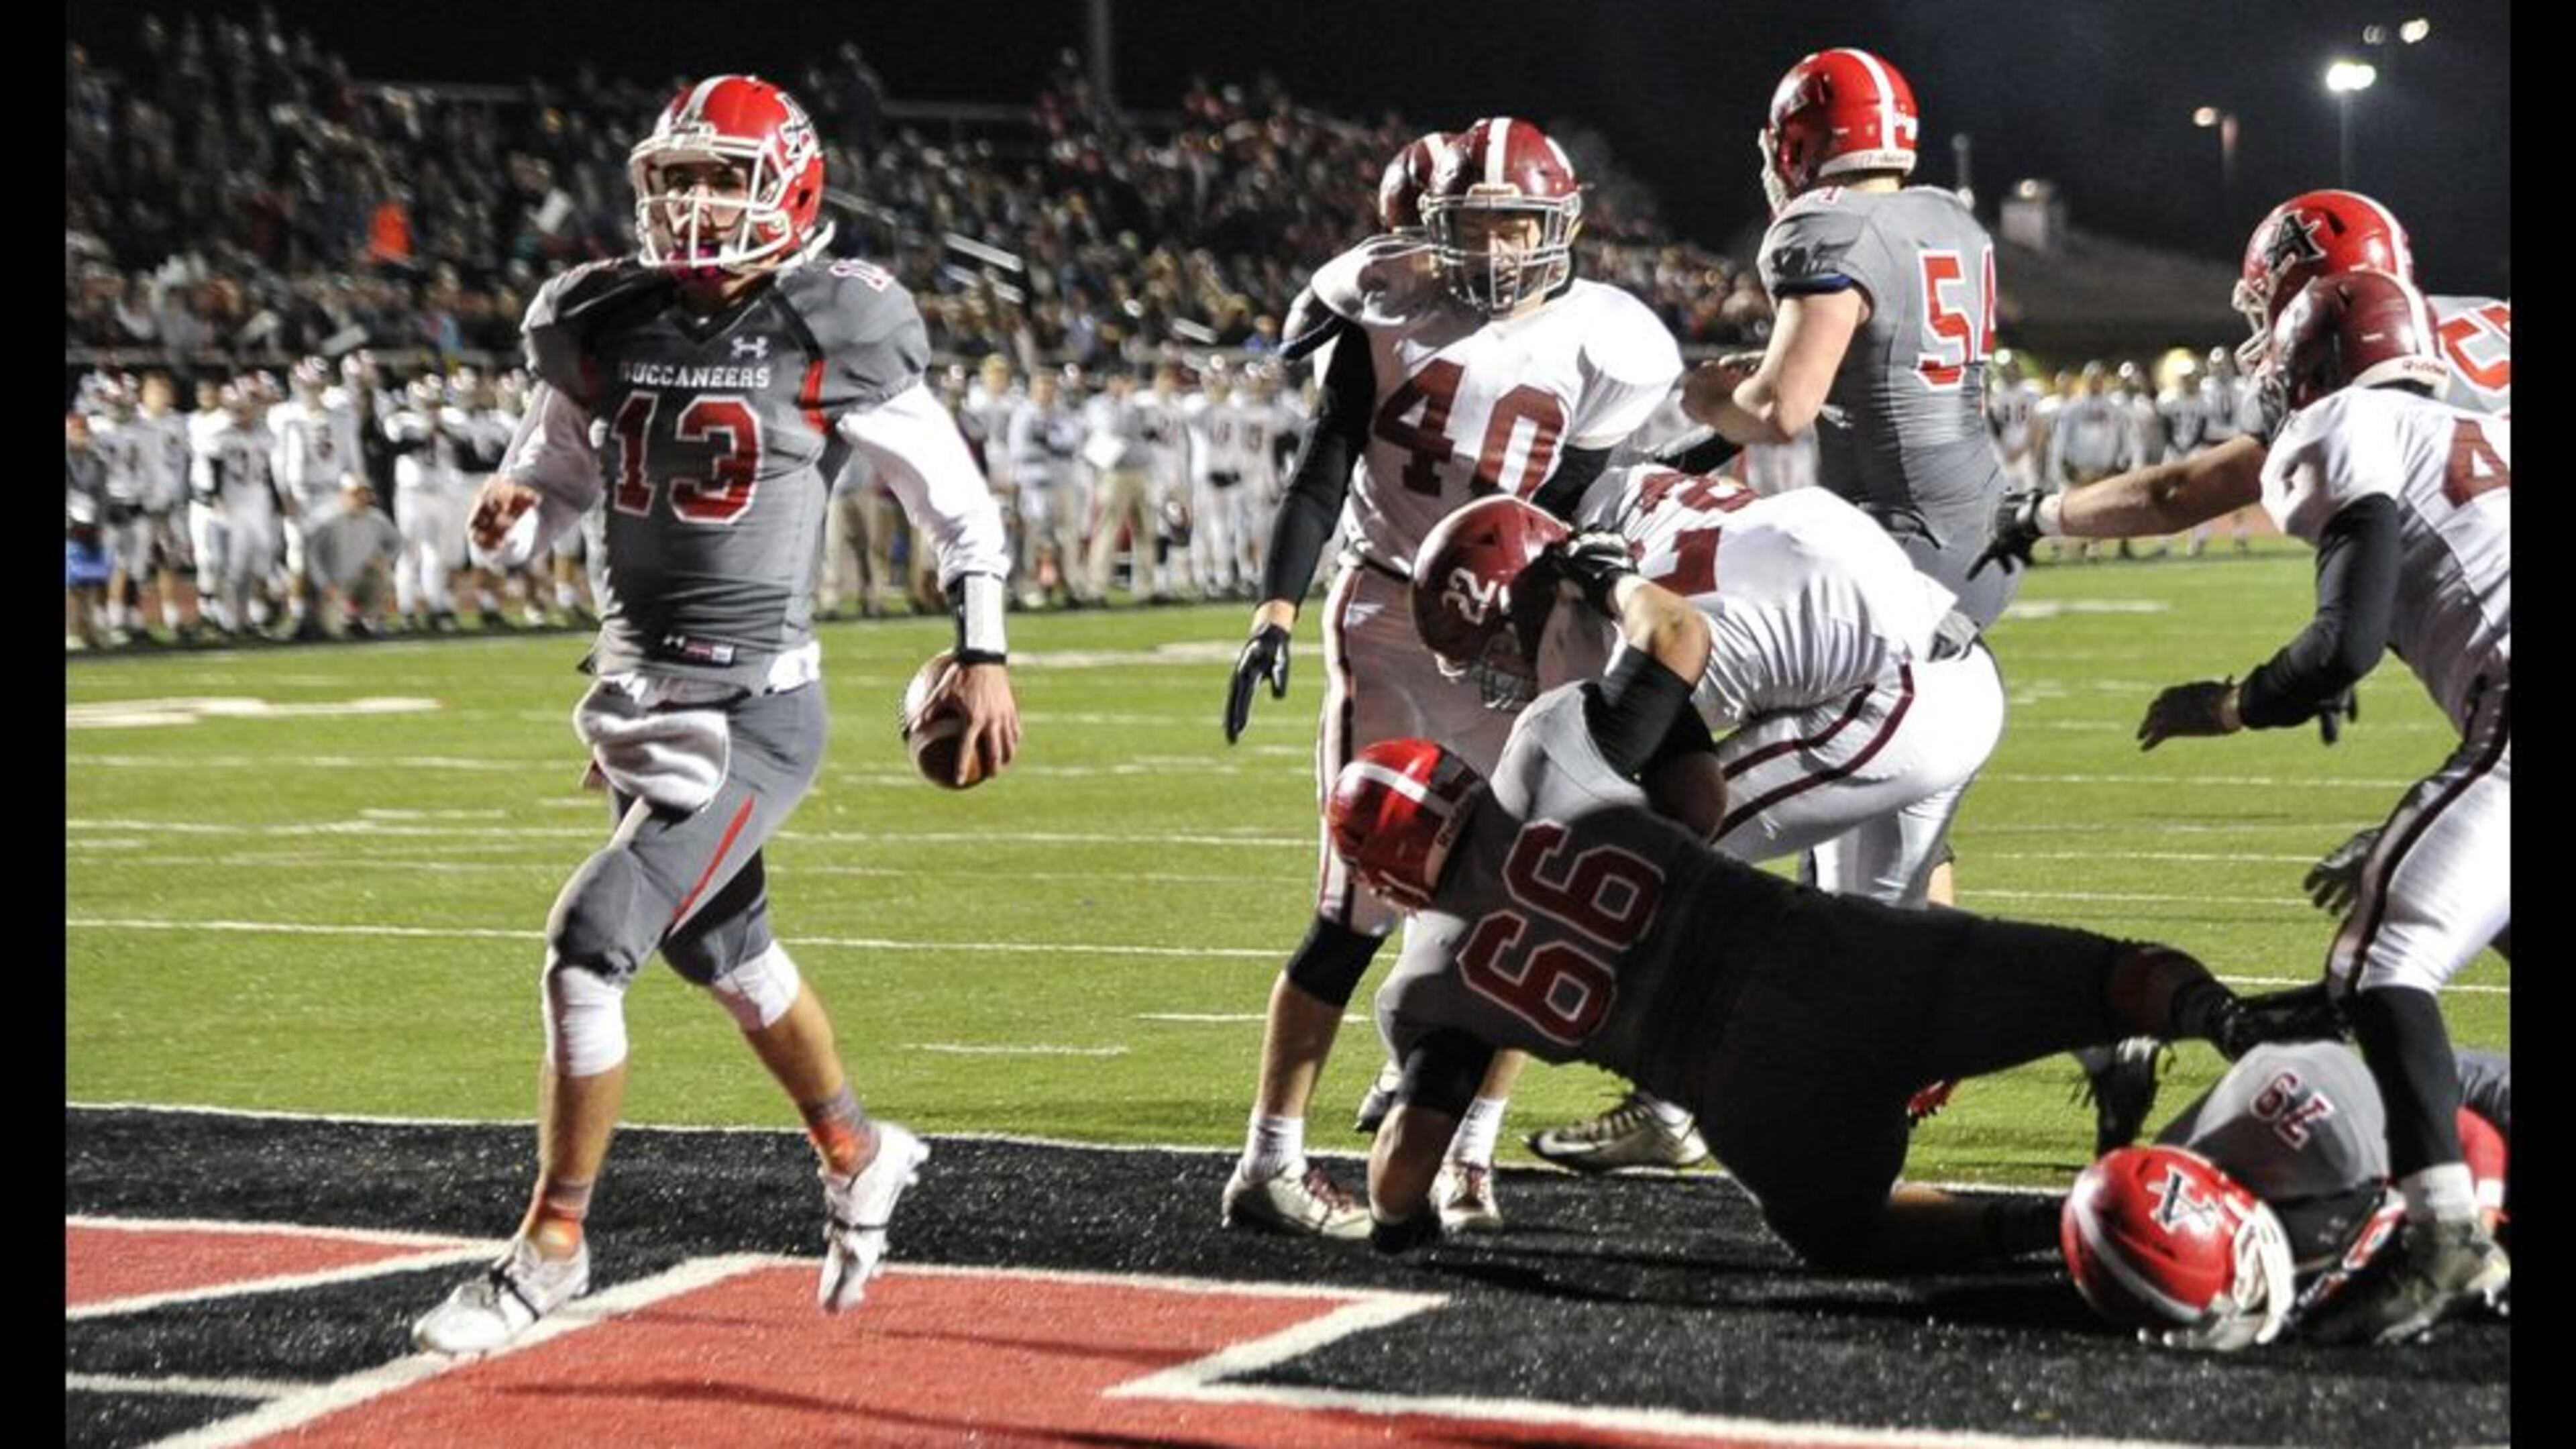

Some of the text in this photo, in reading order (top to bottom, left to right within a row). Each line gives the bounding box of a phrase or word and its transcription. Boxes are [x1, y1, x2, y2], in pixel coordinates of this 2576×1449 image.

[617, 361, 771, 388] UCCANEERS
[1375, 358, 1569, 502] 40
[611, 390, 761, 525] 13
[1456, 818, 1666, 1046] 66
